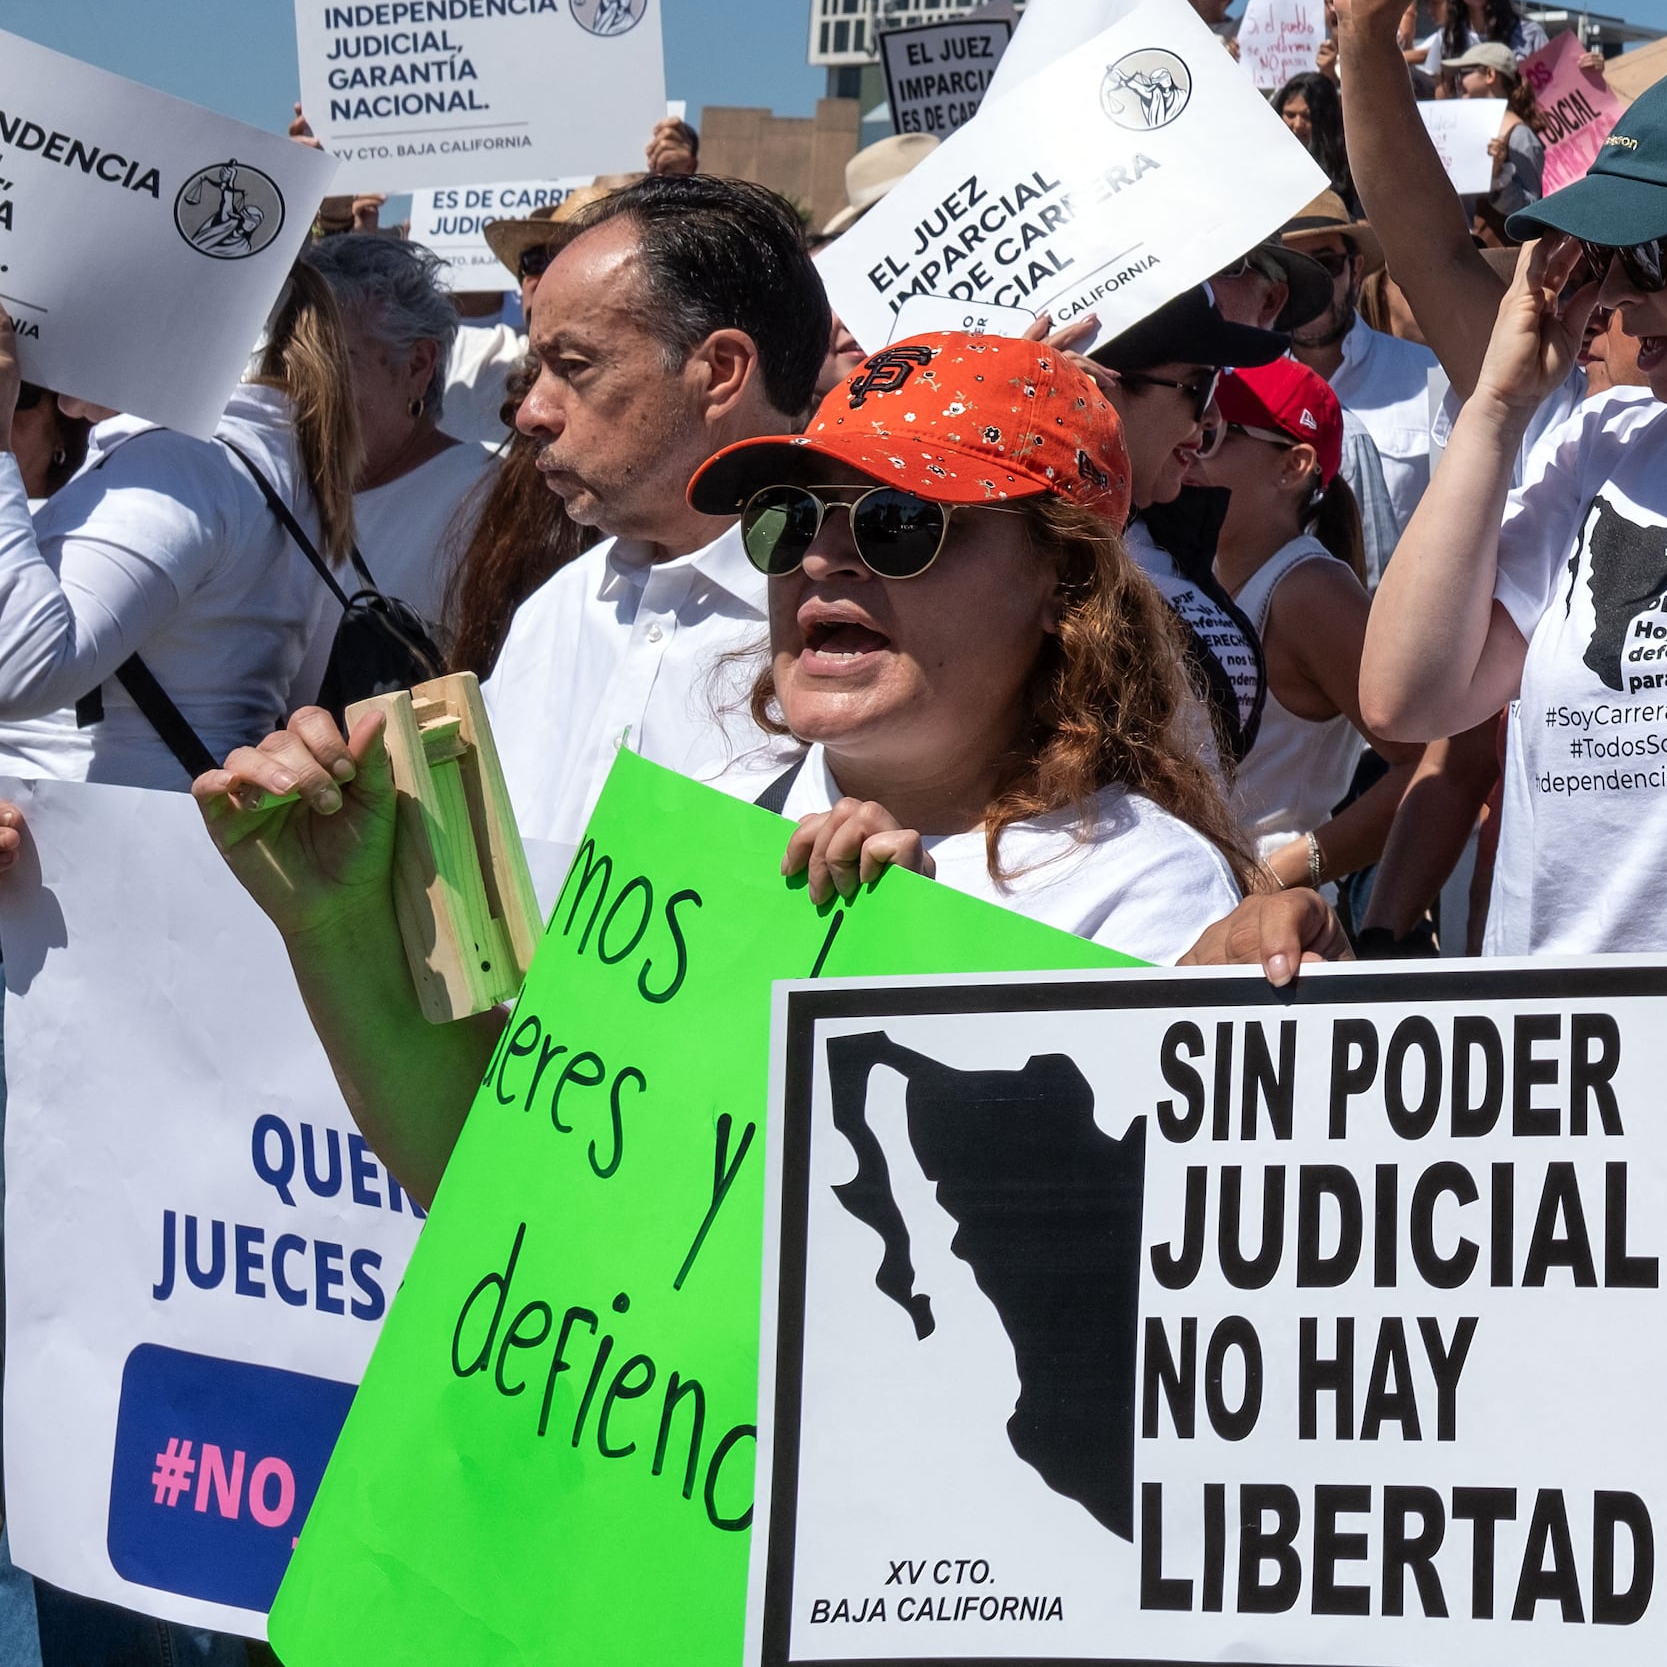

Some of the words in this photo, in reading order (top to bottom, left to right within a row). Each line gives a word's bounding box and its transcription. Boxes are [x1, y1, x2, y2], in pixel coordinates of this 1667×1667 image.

[326, 30, 463, 61] JUDICIAL,
[907, 43, 933, 66] EL
[940, 36, 994, 62] JUEZ
[328, 54, 478, 90] GARANTÍA
[331, 88, 490, 121] NACIONAL.
[902, 109, 922, 133] ES
[925, 105, 946, 131] DE
[357, 145, 393, 161] CTO.
[397, 141, 437, 157] BAJA
[440, 134, 533, 154] CALIFORNIA
[433, 190, 458, 209] ES
[465, 190, 493, 209] DE
[867, 256, 910, 293] EL
[913, 175, 988, 256] JUEZ
[888, 171, 1062, 316] IMPARCIAL
[948, 262, 994, 302] DE
[1057, 253, 1161, 324] CALIFORNIA
[1156, 1019, 1297, 1143] SIN
[1327, 1013, 1624, 1140] PODER
[674, 1111, 756, 1291] y
[1150, 1161, 1660, 1290] JUDICIAL
[152, 1209, 387, 1322] JUECES
[1141, 1316, 1264, 1443] NO
[1297, 1316, 1480, 1443] HAY
[885, 1559, 928, 1587] XV
[932, 1559, 997, 1587] CTO.
[1139, 1482, 1656, 1626] LIBERTAD
[810, 1597, 889, 1626] BAJA
[895, 1595, 1065, 1625] CALIFORNIA
